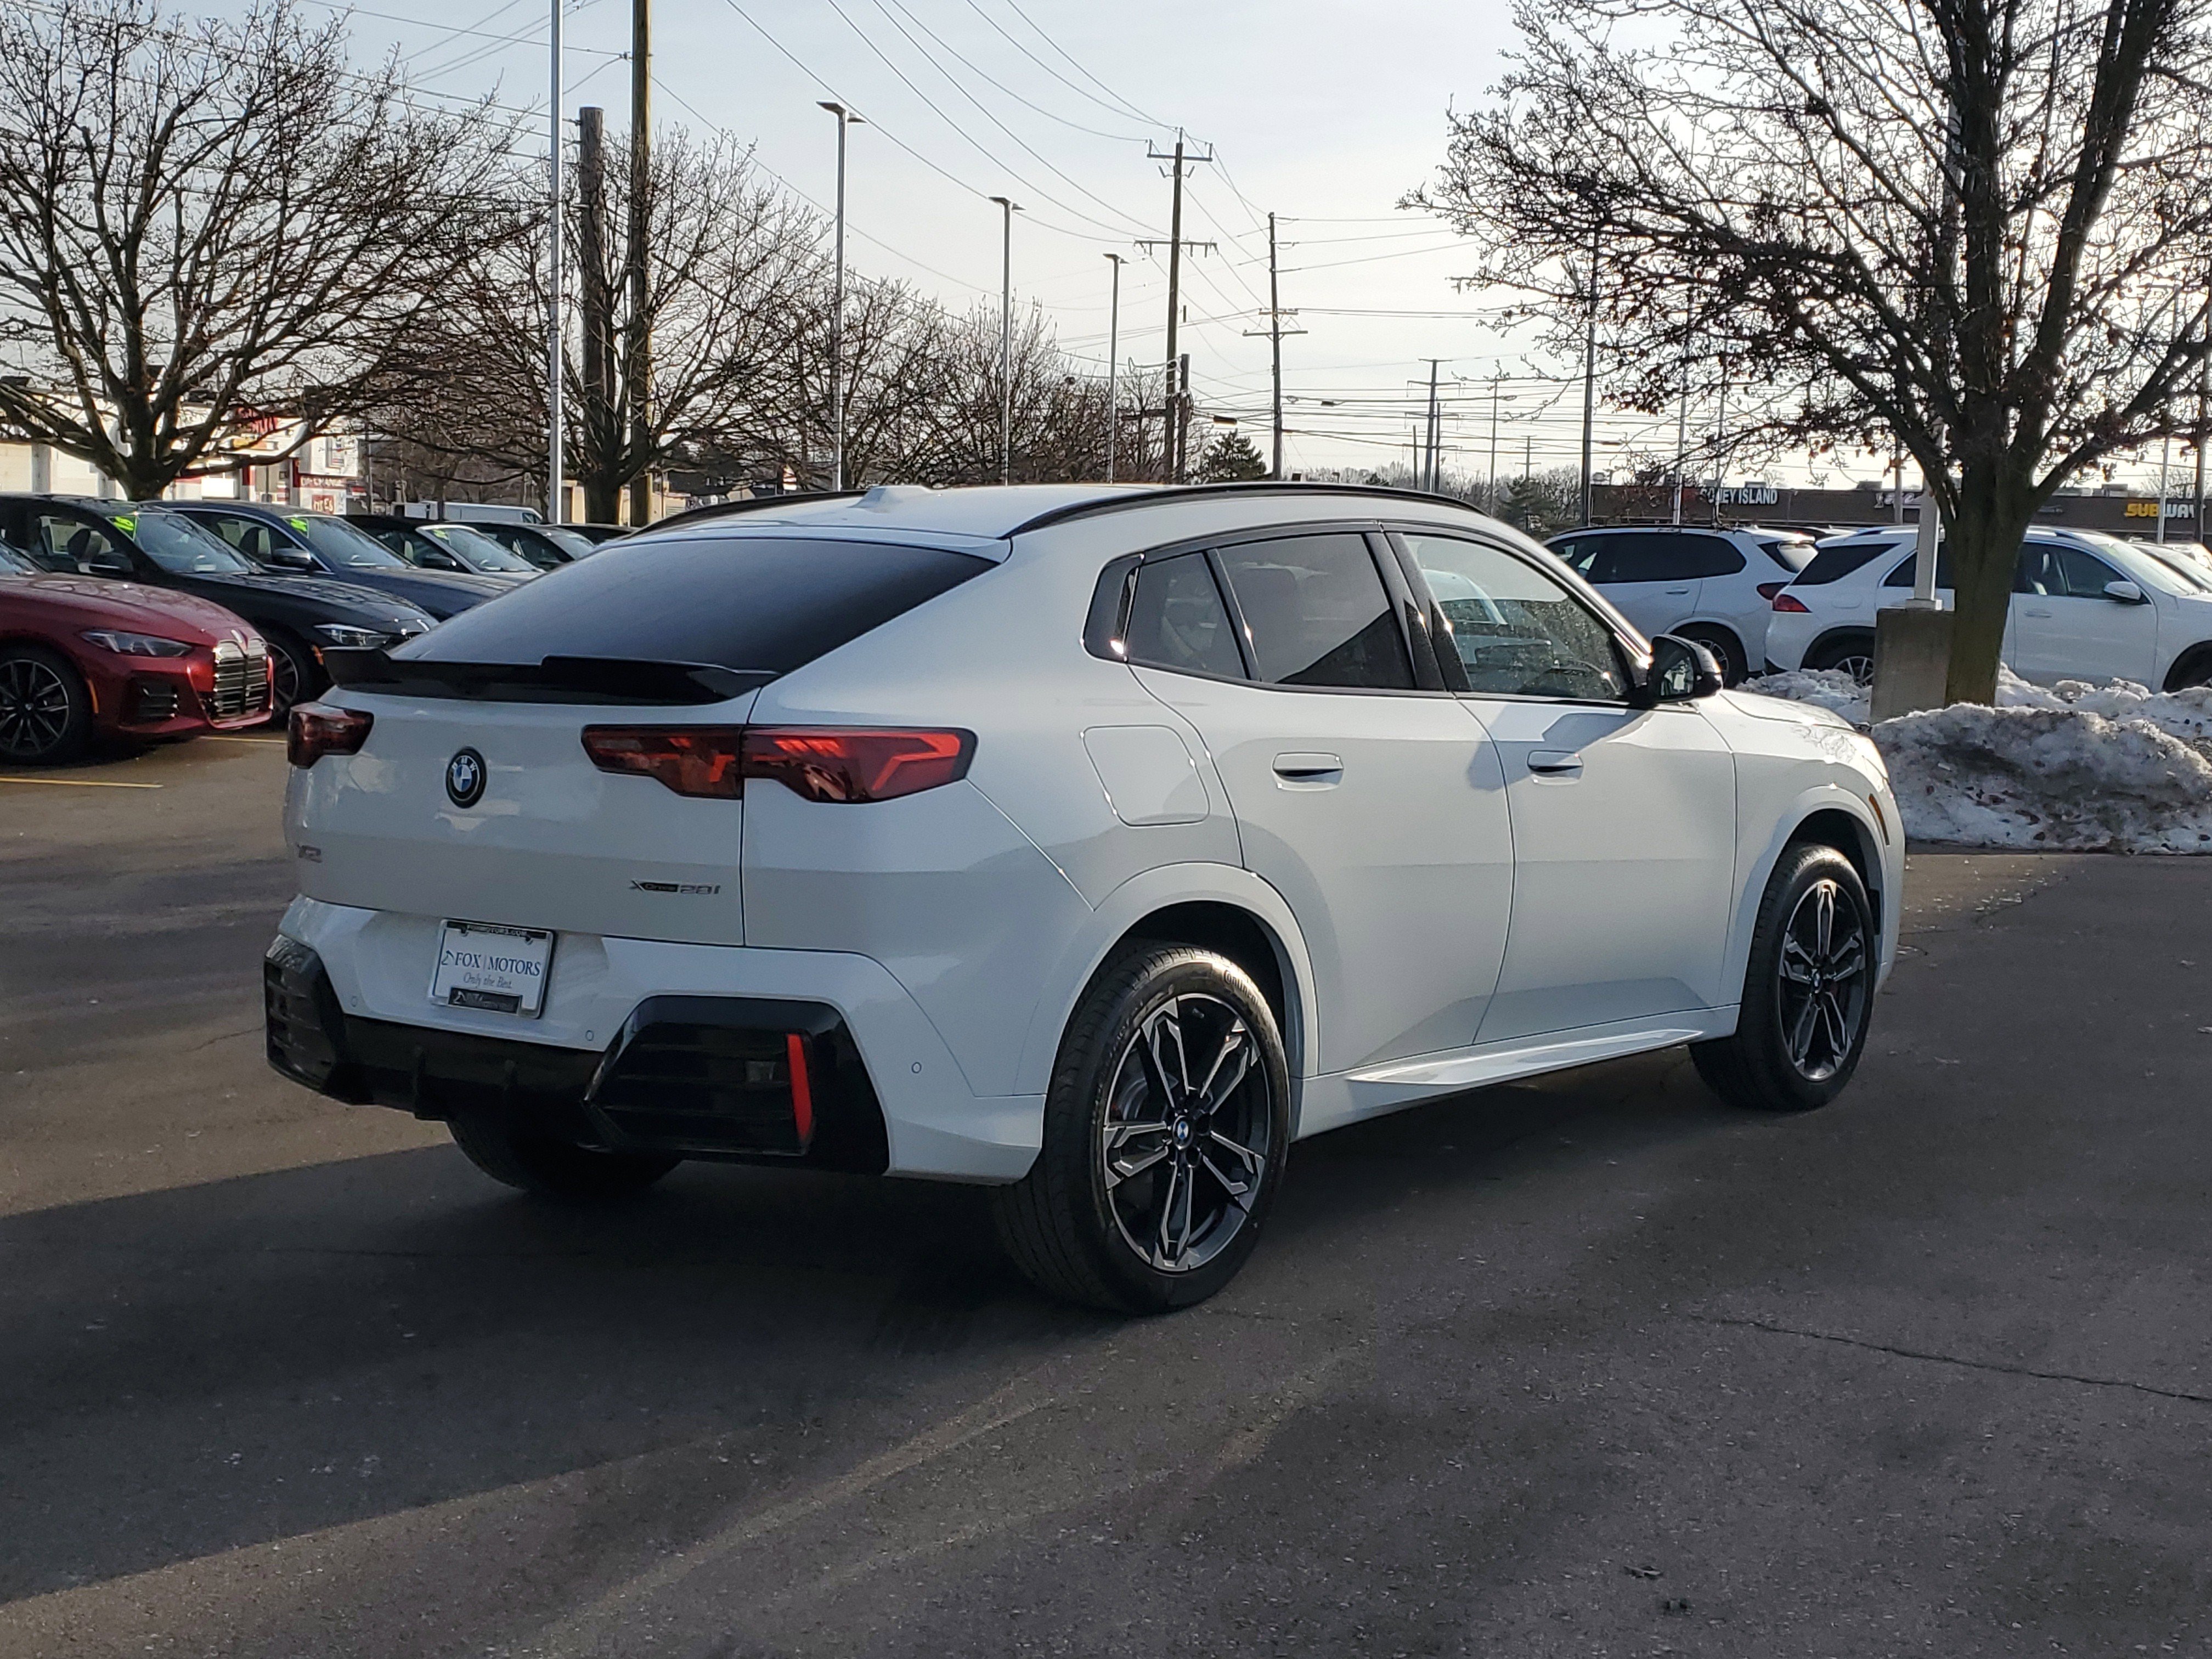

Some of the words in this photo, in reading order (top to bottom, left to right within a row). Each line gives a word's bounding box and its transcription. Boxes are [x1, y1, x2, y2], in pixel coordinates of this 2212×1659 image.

[1739, 488, 1778, 505] ISLAND
[455, 952, 481, 968] FOX
[488, 956, 541, 976] MOTORS
